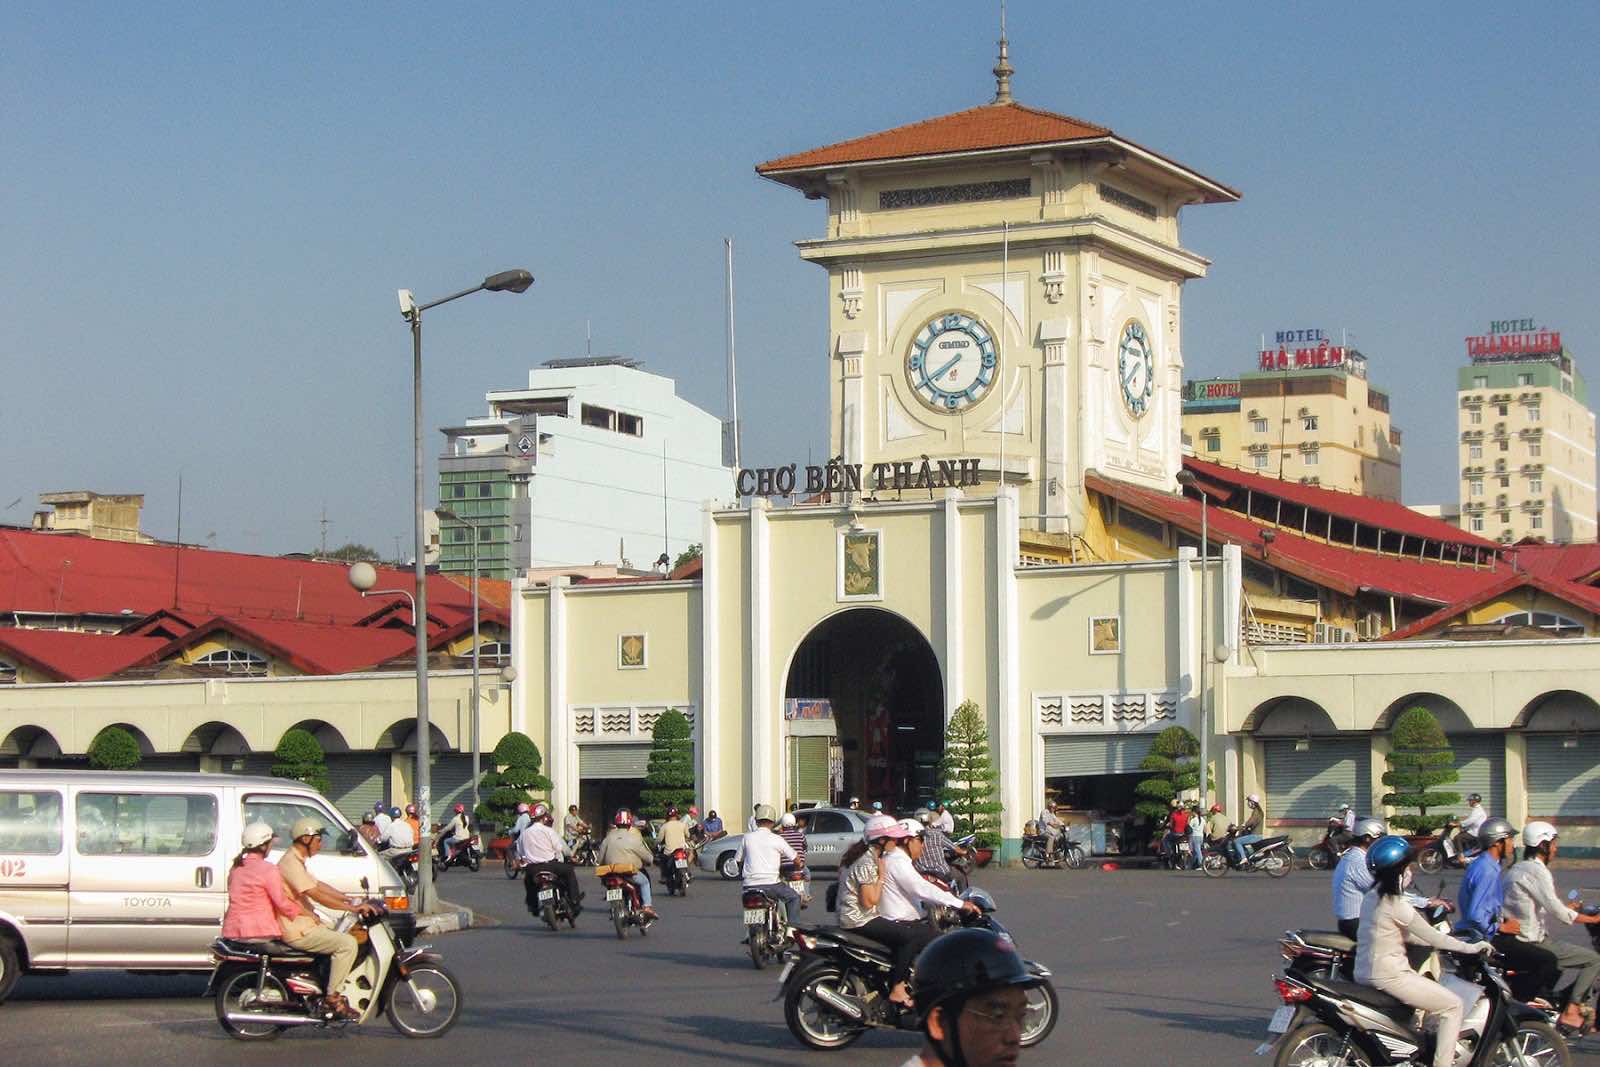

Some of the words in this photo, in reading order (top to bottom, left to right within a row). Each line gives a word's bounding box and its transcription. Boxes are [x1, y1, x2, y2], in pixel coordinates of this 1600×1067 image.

[1490, 319, 1537, 334] HOTEL
[1275, 328, 1323, 343] HOTEL
[736, 463, 797, 498] CHỢ
[805, 455, 862, 494] BẾN
[872, 454, 981, 490] THÀNH
[123, 897, 172, 907] TOYOTA
